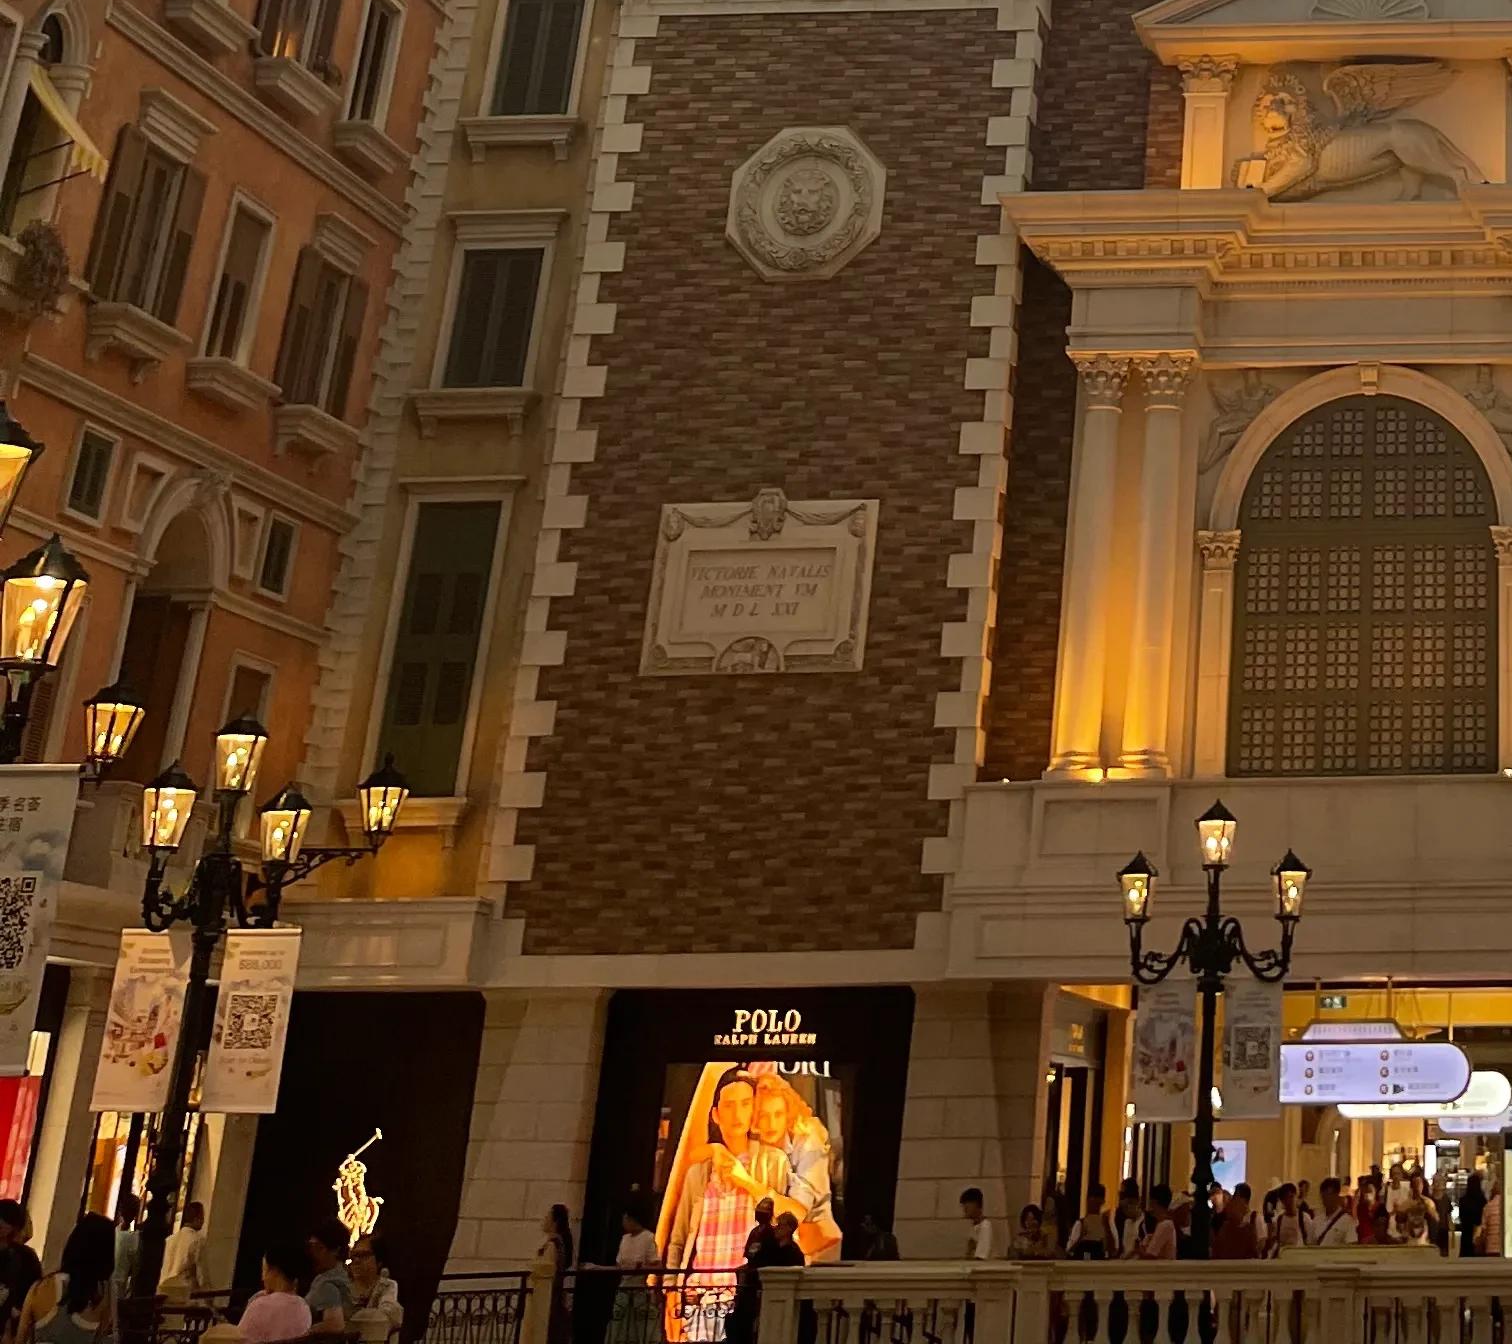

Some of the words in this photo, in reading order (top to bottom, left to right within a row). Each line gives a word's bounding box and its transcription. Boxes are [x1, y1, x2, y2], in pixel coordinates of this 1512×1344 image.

[732, 1009, 802, 1033] POLO
[714, 1034, 758, 1045] RALPH
[764, 1033, 817, 1045] LAUREN
